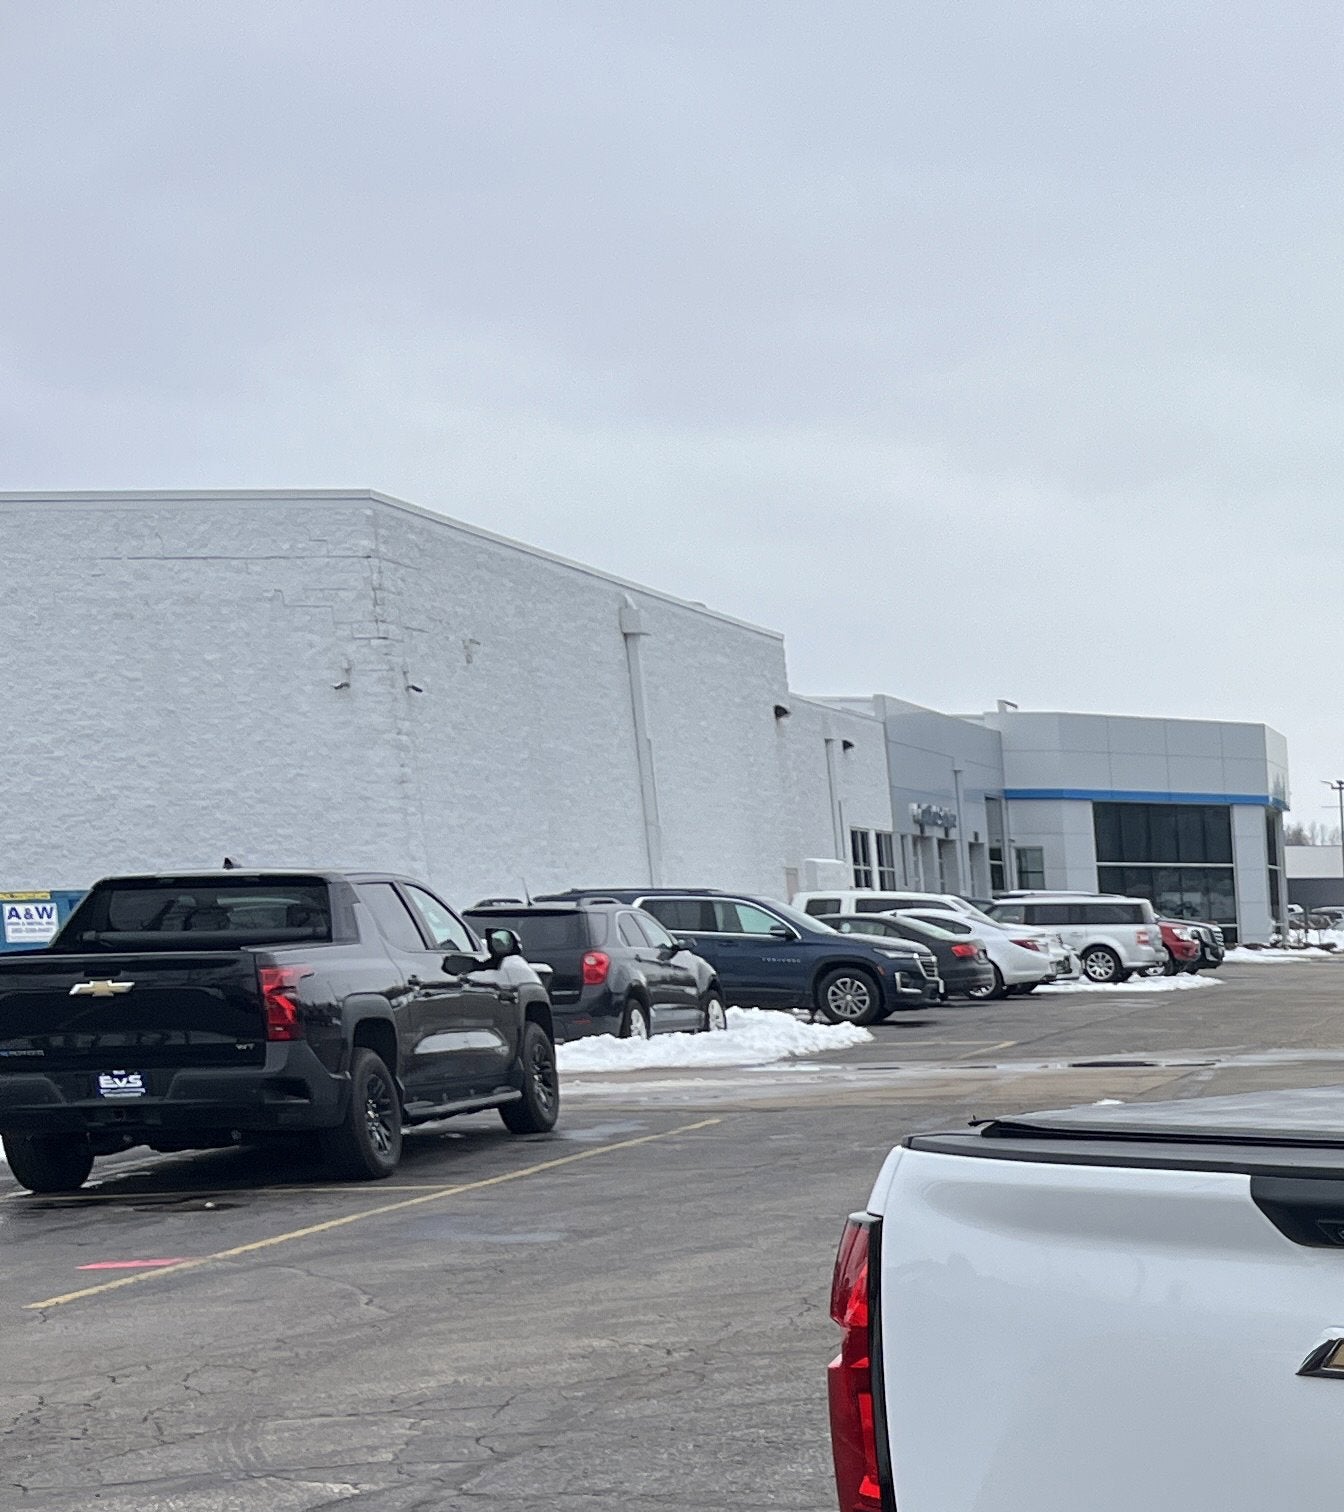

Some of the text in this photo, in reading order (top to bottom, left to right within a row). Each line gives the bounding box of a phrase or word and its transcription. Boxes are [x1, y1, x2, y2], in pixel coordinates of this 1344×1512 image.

[8, 906, 53, 920] A & W
